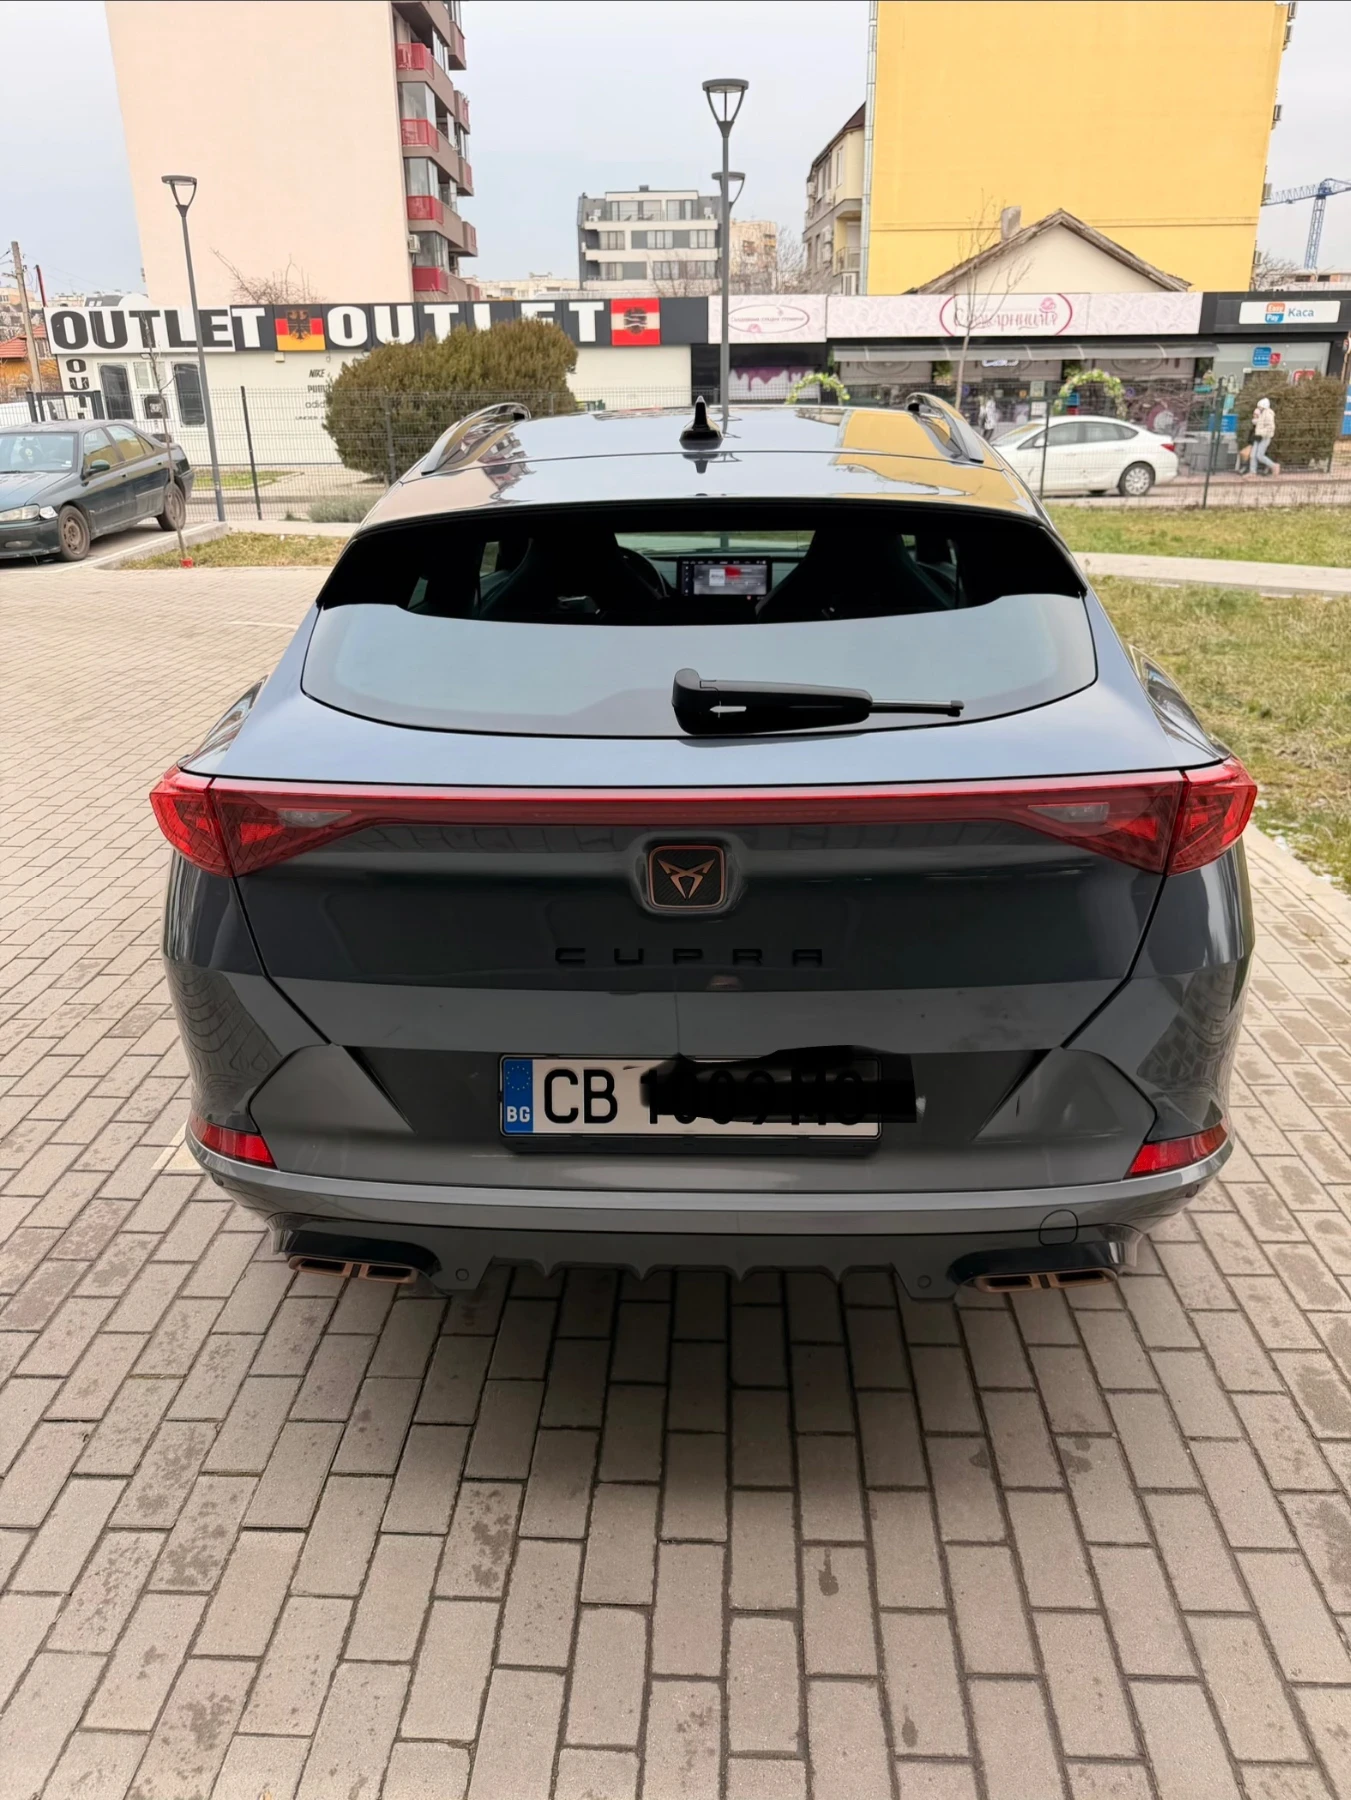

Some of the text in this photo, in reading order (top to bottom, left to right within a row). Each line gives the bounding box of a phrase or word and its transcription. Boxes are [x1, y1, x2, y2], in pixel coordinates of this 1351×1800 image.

[1268, 304, 1285, 313] Easy
[1266, 314, 1280, 323] Pay
[50, 307, 266, 349] OUTLET
[309, 368, 326, 378] NIKE
[555, 947, 823, 966] CUPRA
[506, 1106, 531, 1123] BG
